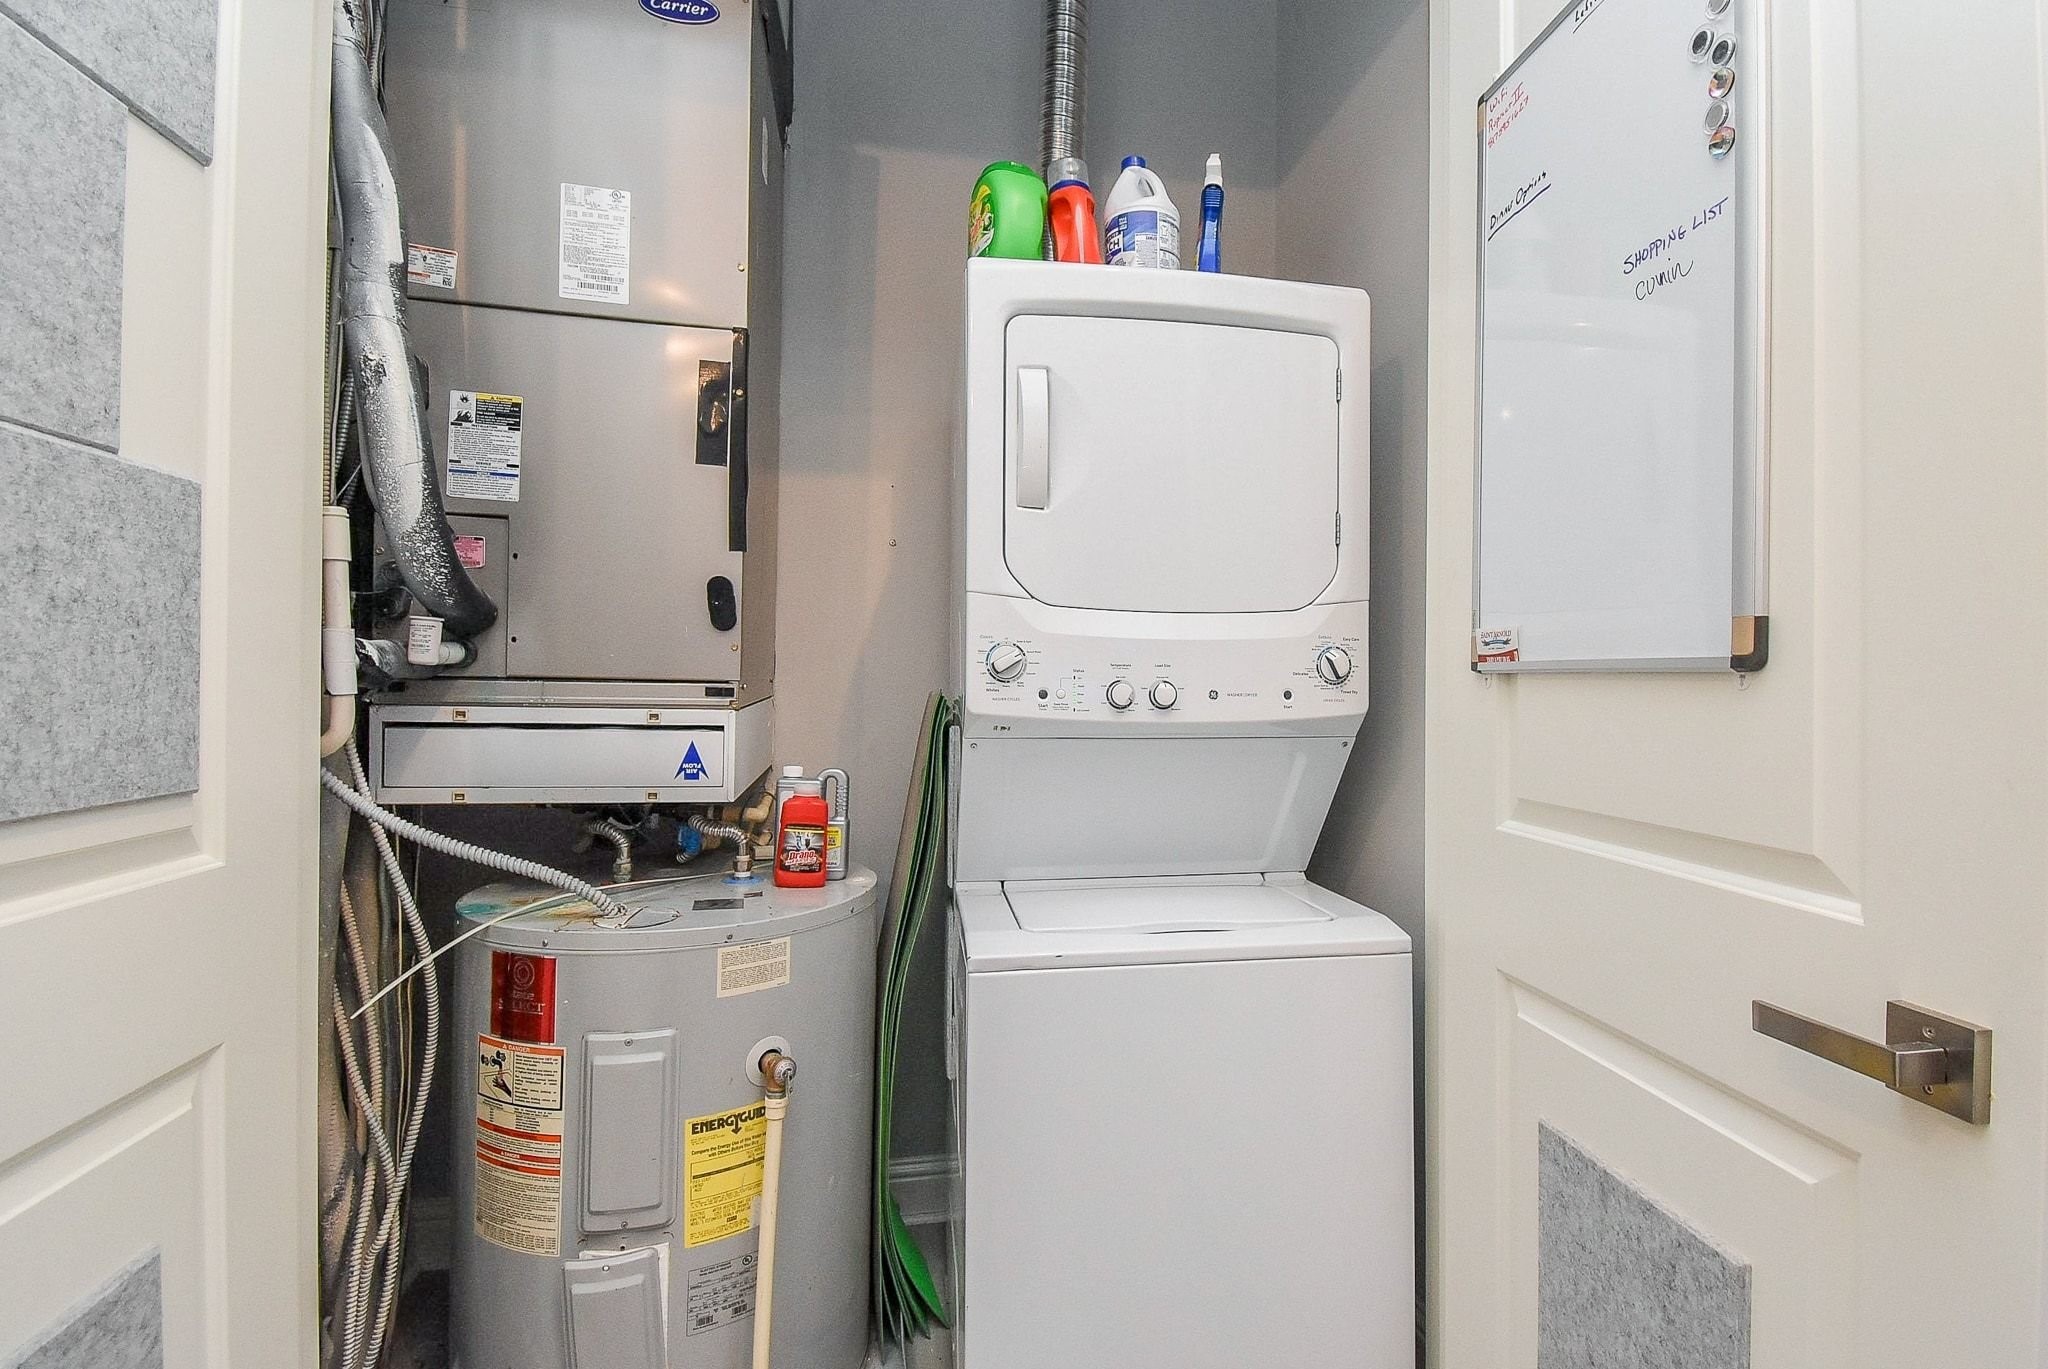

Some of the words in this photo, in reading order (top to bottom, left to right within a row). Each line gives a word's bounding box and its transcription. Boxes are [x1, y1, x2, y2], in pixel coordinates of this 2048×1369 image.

[650, 0, 708, 16] Carrier
[1623, 225, 1687, 275] SHOPPING
[1692, 196, 1729, 230] LIST
[789, 850, 815, 860] Drano
[508, 1044, 531, 1053] DANGER
[691, 1105, 767, 1135] ENERGYGUID
[692, 1148, 710, 1156] Compare
